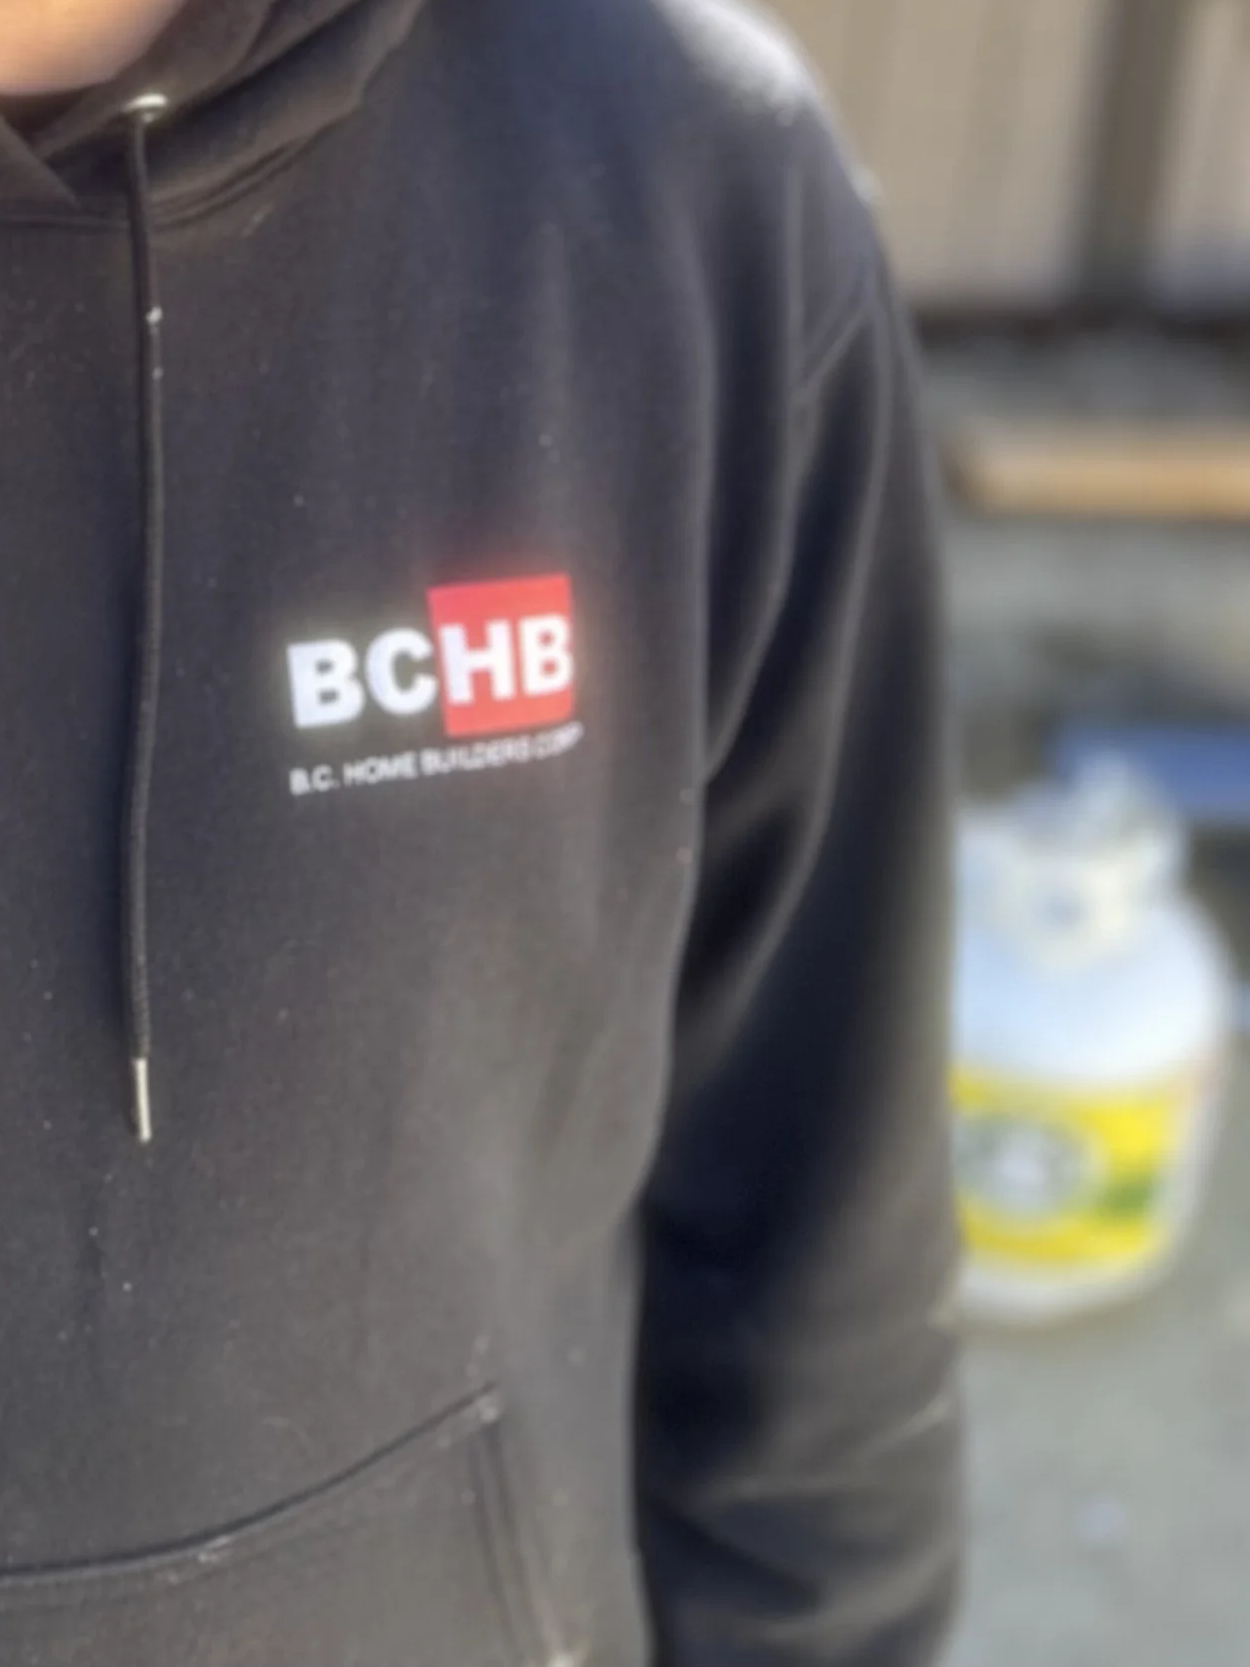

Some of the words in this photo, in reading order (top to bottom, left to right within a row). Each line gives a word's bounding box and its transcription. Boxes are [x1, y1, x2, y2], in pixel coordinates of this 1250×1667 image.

[287, 613, 574, 729] BCHB
[288, 764, 340, 797] B.C.
[343, 750, 418, 786] HOME
